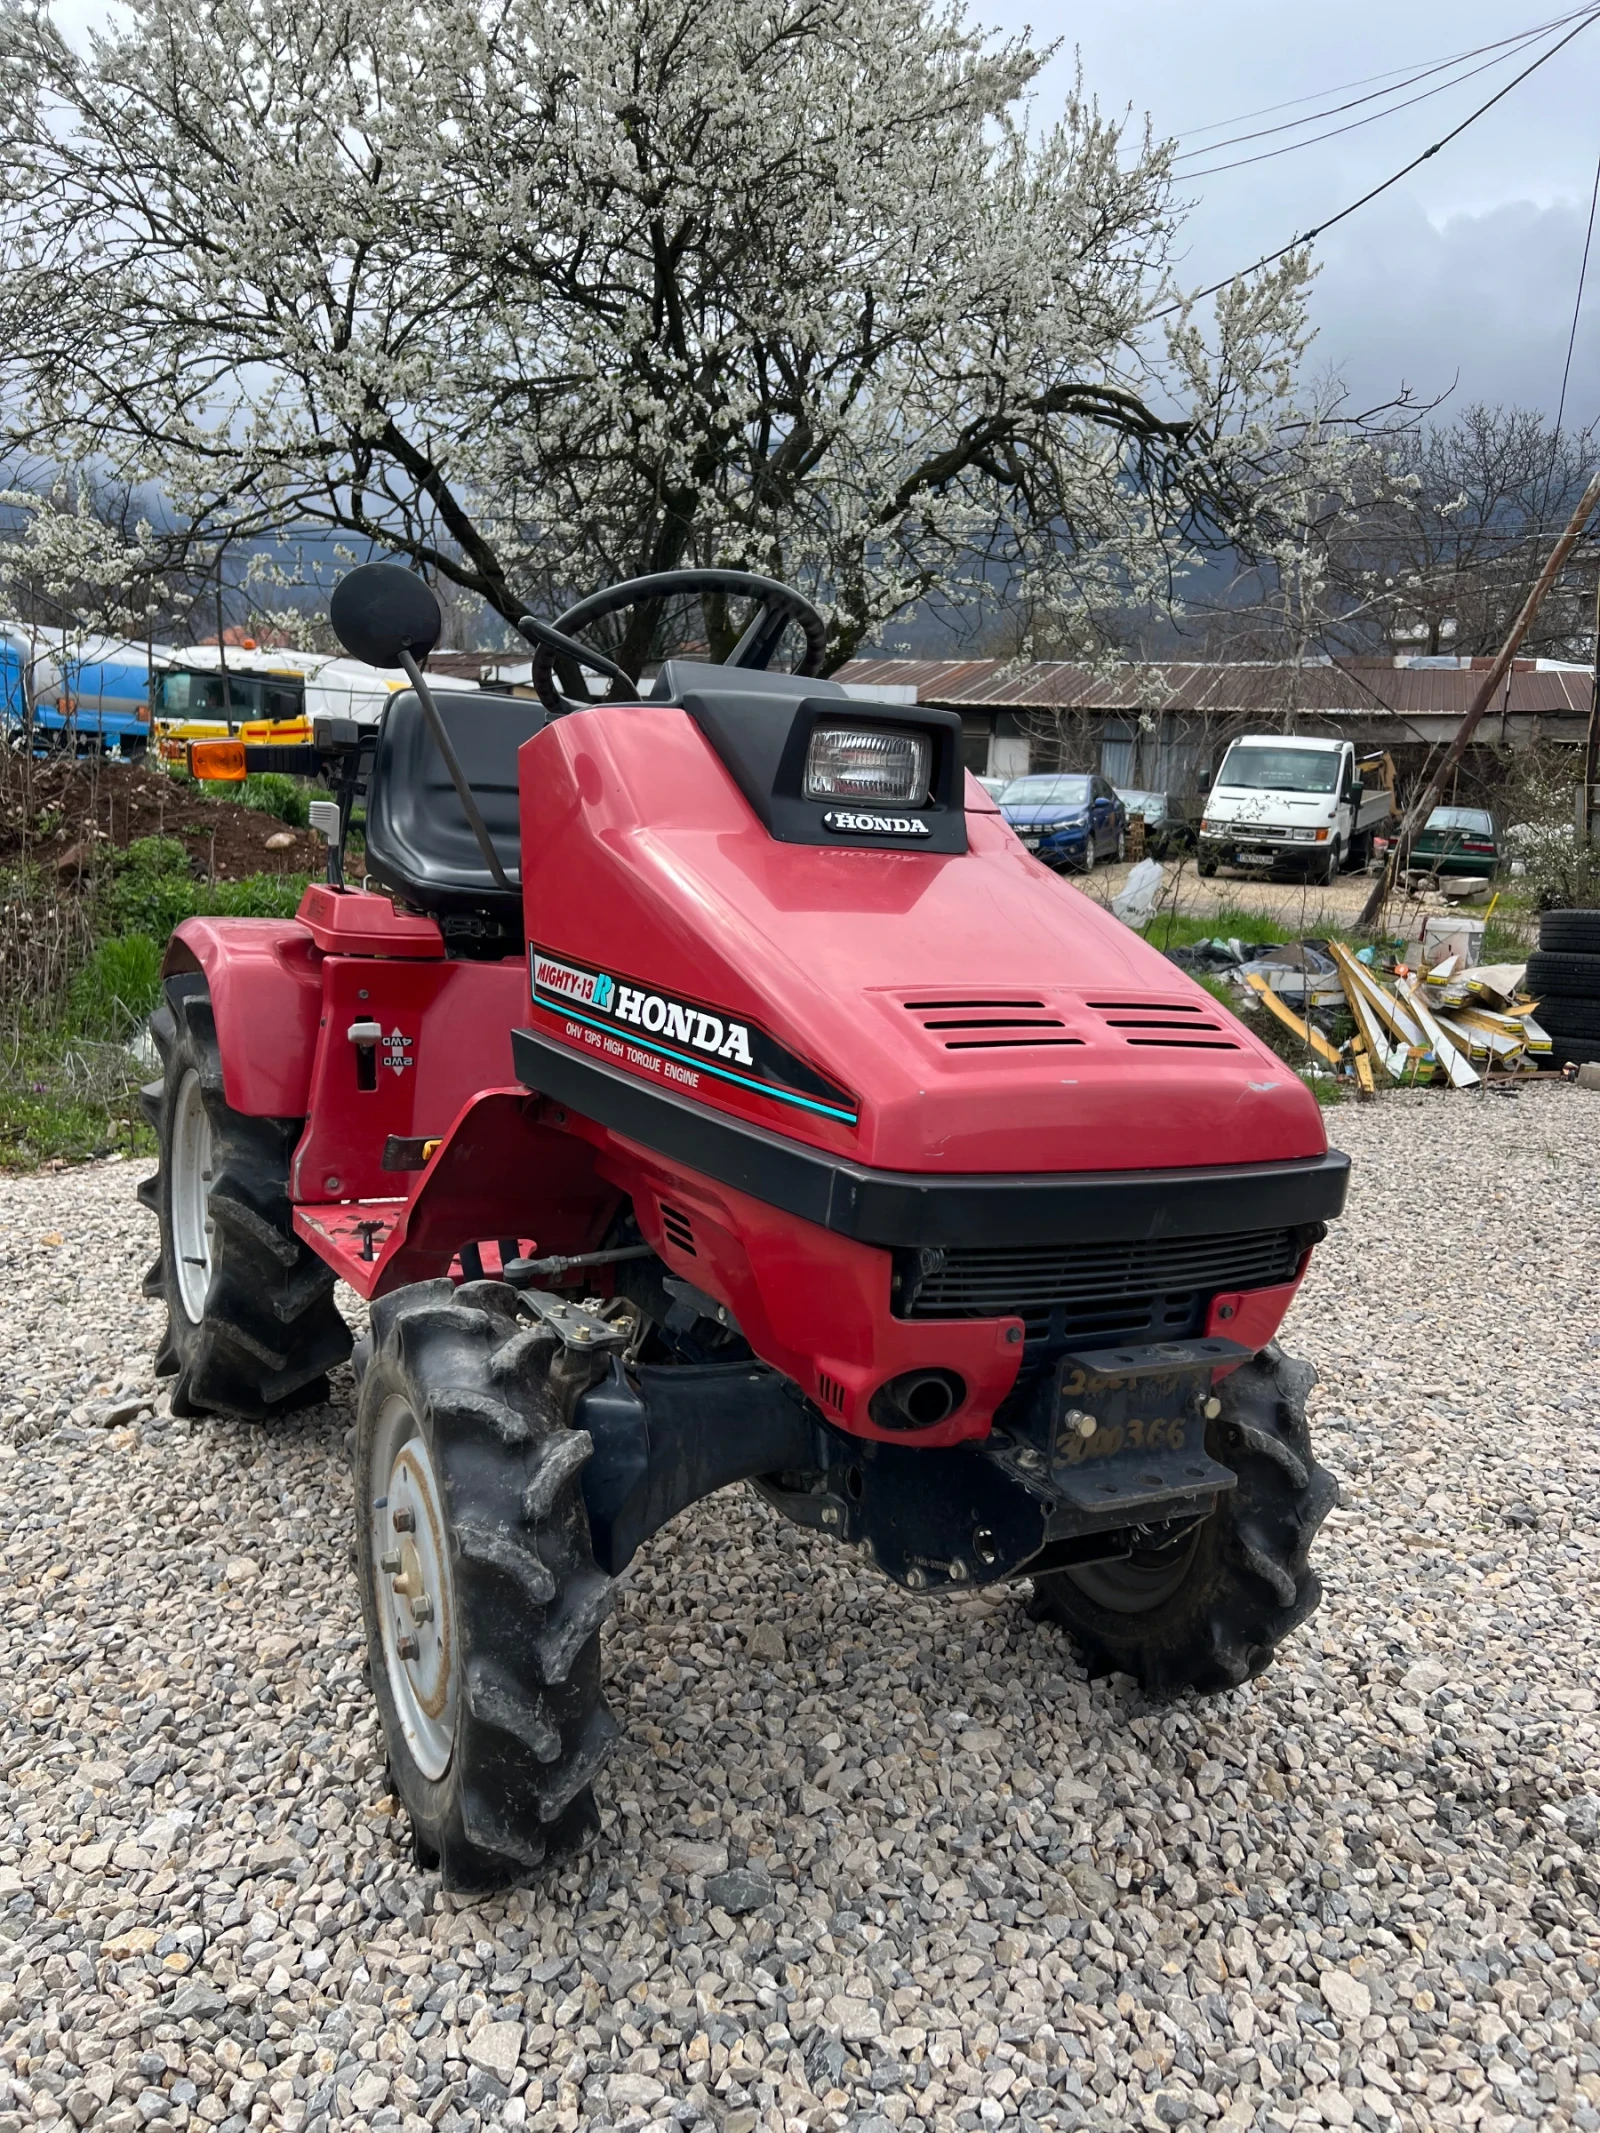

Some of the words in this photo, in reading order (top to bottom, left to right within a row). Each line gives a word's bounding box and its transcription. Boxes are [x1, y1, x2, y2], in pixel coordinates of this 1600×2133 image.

[835, 812, 929, 833] HONDA
[615, 985, 753, 1066] HONDA
[382, 1037, 412, 1046] 4WD
[383, 1057, 413, 1066] 2WD
[565, 1021, 582, 1040] OHV
[584, 1029, 602, 1048] 13PS
[603, 1037, 624, 1058] HIGH
[626, 1046, 661, 1073] TORQUE
[664, 1062, 699, 1088] ENGINE
